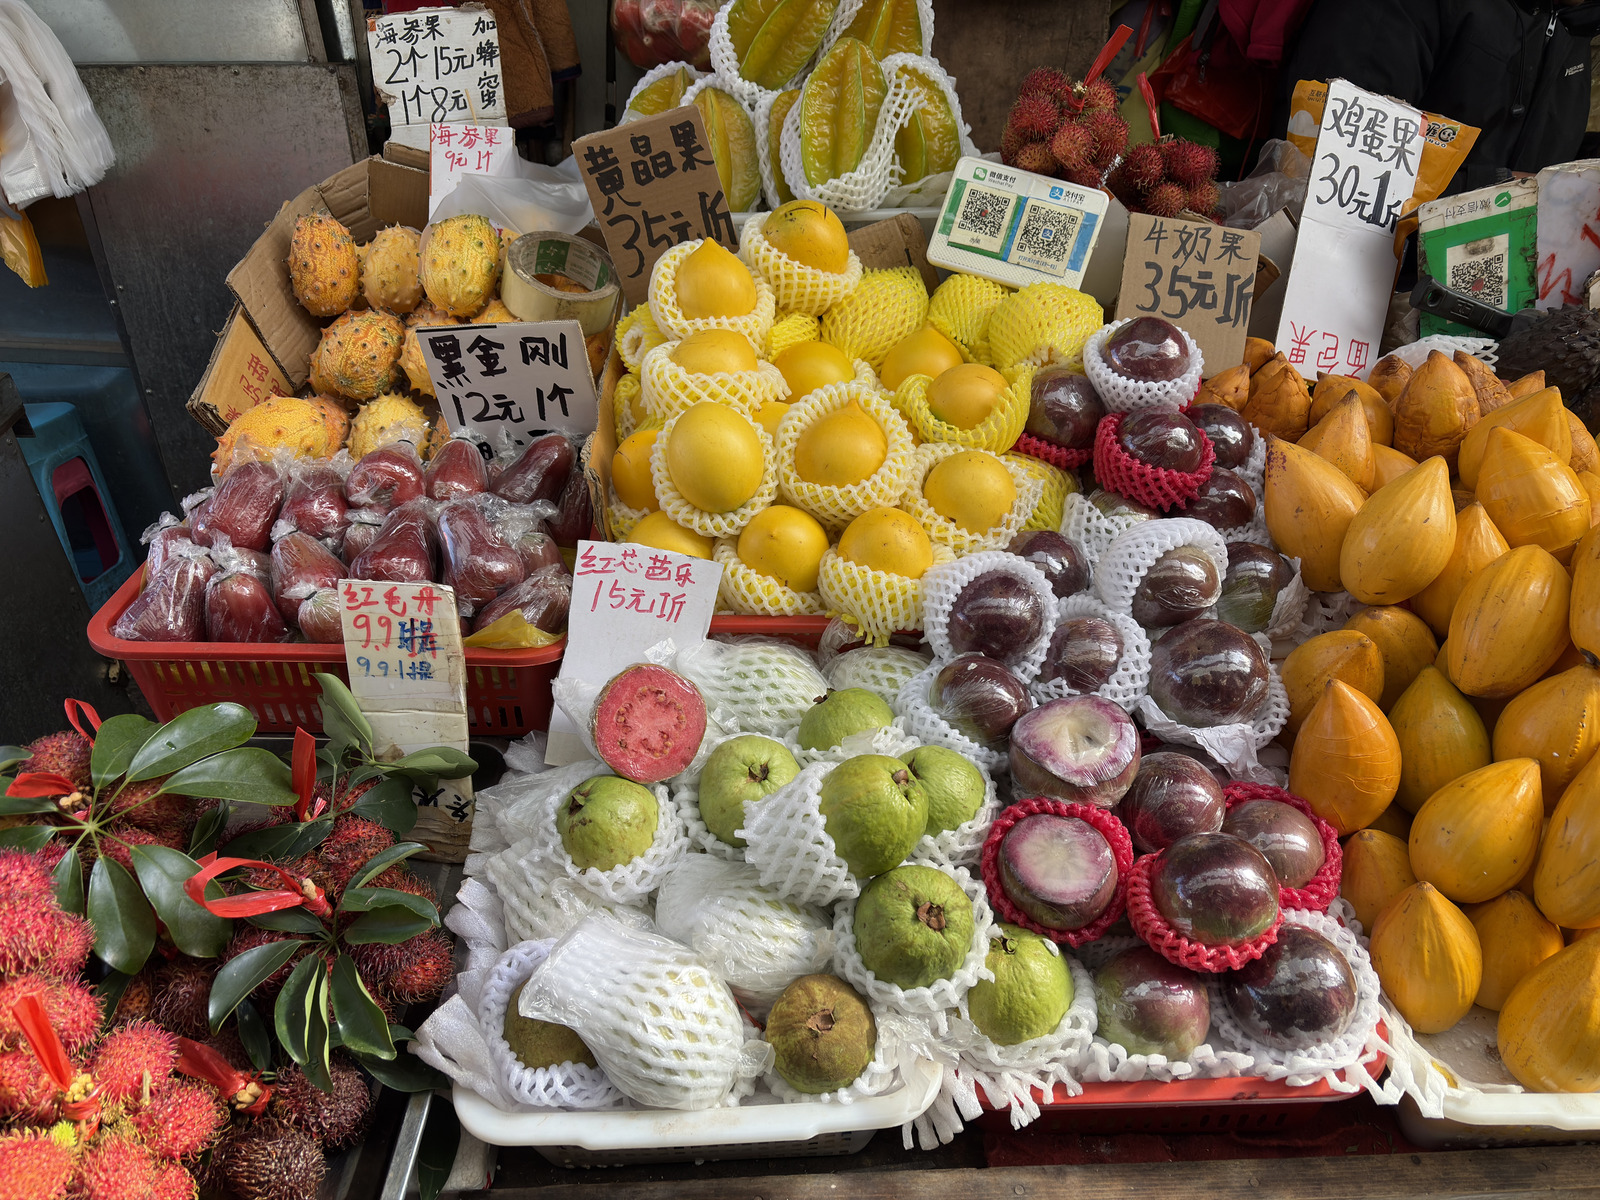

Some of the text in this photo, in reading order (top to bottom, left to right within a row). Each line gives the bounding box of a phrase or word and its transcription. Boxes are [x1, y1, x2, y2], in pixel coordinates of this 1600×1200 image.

[375, 15, 444, 48] 海参果
[431, 123, 501, 149] 海参果
[1324, 96, 1419, 177] 鸡蛋果
[584, 120, 714, 216] 黄晶果
[989, 171, 1016, 184] 微信支付
[1064, 189, 1085, 201] 支付宝
[1445, 198, 1491, 220] 微信支付
[1144, 218, 1252, 269] 牛奶果
[428, 332, 568, 389] 黑金刚
[1289, 321, 1370, 380] 面包果
[577, 545, 696, 588] 红芯芭乐
[343, 583, 442, 616] 红毛丹
